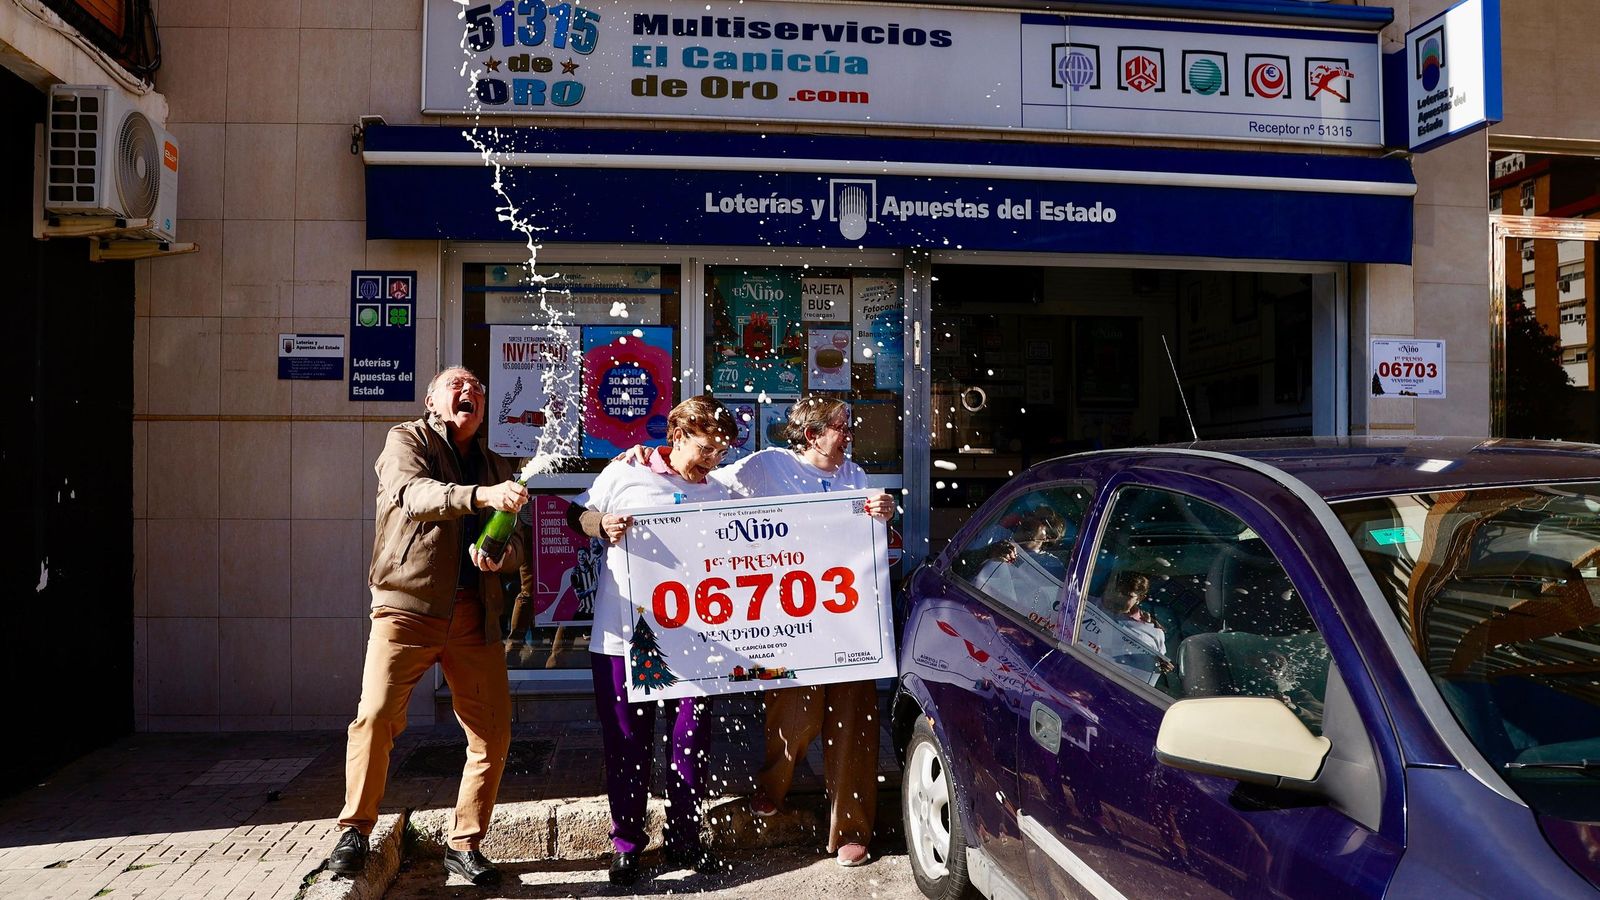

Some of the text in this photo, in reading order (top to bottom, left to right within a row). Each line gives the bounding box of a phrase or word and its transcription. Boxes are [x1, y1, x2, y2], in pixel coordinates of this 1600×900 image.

[465, 0, 601, 55] 51315
[633, 14, 953, 48] Multiservicios
[508, 54, 553, 73] de
[633, 45, 869, 75] El Capicúa
[476, 78, 586, 107] ORO
[632, 74, 869, 104] de Oro .com
[1417, 86, 1454, 110] Loterías y
[1418, 91, 1466, 123] Apuestas del
[1249, 121, 1352, 137] Receptor nº 51315
[1417, 117, 1444, 136] Estado
[706, 192, 1117, 223] Loterías y Apuestas del Estado
[742, 282, 784, 301] Niño
[802, 283, 845, 295] ARJETA
[808, 299, 832, 311] BUS
[503, 343, 568, 362] INVIERNO
[353, 358, 399, 369] Loterías y
[1379, 362, 1437, 378] 06703
[353, 372, 413, 383] Apuestas del
[718, 368, 739, 381] 770
[353, 386, 385, 395] Estado
[622, 406, 646, 415] AÑOS
[640, 518, 651, 526] DE
[653, 517, 681, 525] ENERO
[715, 518, 788, 542] El Niño
[542, 537, 561, 545] SOMOS
[542, 546, 575, 554] LA QUINIELA
[728, 550, 804, 571] PREMIO
[652, 566, 859, 629] 06703
[698, 620, 812, 643] VENDIDO AQUÍ
[848, 655, 877, 663] NACIONAL
